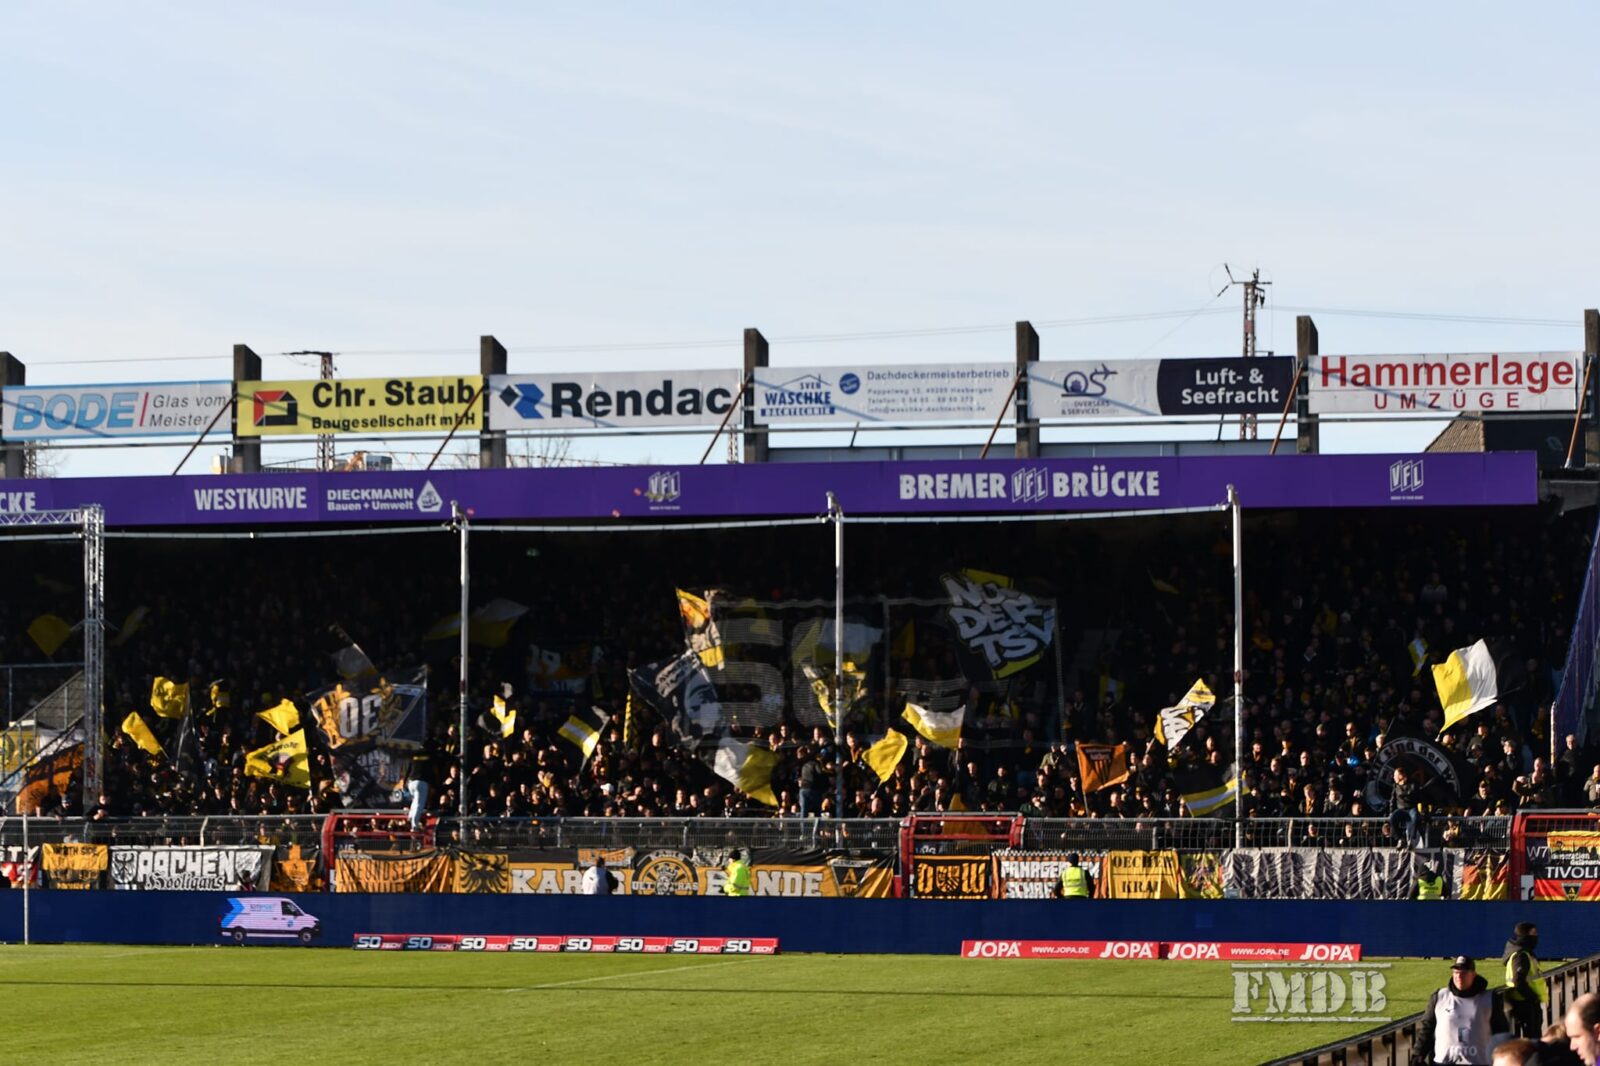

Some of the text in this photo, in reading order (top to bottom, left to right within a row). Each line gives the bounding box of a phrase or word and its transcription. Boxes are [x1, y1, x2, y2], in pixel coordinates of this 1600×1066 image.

[867, 369, 1010, 381] Dachdeckermeisterbetrieb
[1195, 368, 1264, 385] Luft- &
[1321, 355, 1574, 393] Hammerlage
[312, 378, 475, 408] Chr. Staub
[551, 379, 732, 418] Rendac
[764, 391, 831, 406] WASCHKE
[1181, 387, 1280, 405] Seefracht
[153, 394, 227, 409] Glas vom
[13, 392, 139, 430] BODE
[149, 413, 210, 427] Meister
[312, 412, 475, 431] Baugesellschaft mbH
[900, 472, 1007, 500] BREMER
[1053, 465, 1159, 497] BRÜCKE
[194, 487, 307, 511] WESTKURVE
[327, 488, 414, 501] DIECKMANN
[327, 501, 362, 512] Bauen
[372, 500, 414, 511] Umwelt
[137, 850, 235, 883] AACHEN
[1545, 866, 1598, 879] TIVOLI
[705, 870, 823, 897] BNDE
[357, 936, 381, 948] SO
[407, 937, 431, 948] SO
[460, 938, 485, 949] SO
[512, 938, 537, 950] SO
[566, 938, 592, 950] SO
[618, 939, 643, 951] SO
[672, 940, 698, 952] SO
[725, 940, 751, 952] SO
[968, 942, 1153, 958] JOPA WWW.JOPA.DE JOPA
[1167, 943, 1220, 959] JOPA
[1300, 944, 1353, 960] JOPA
